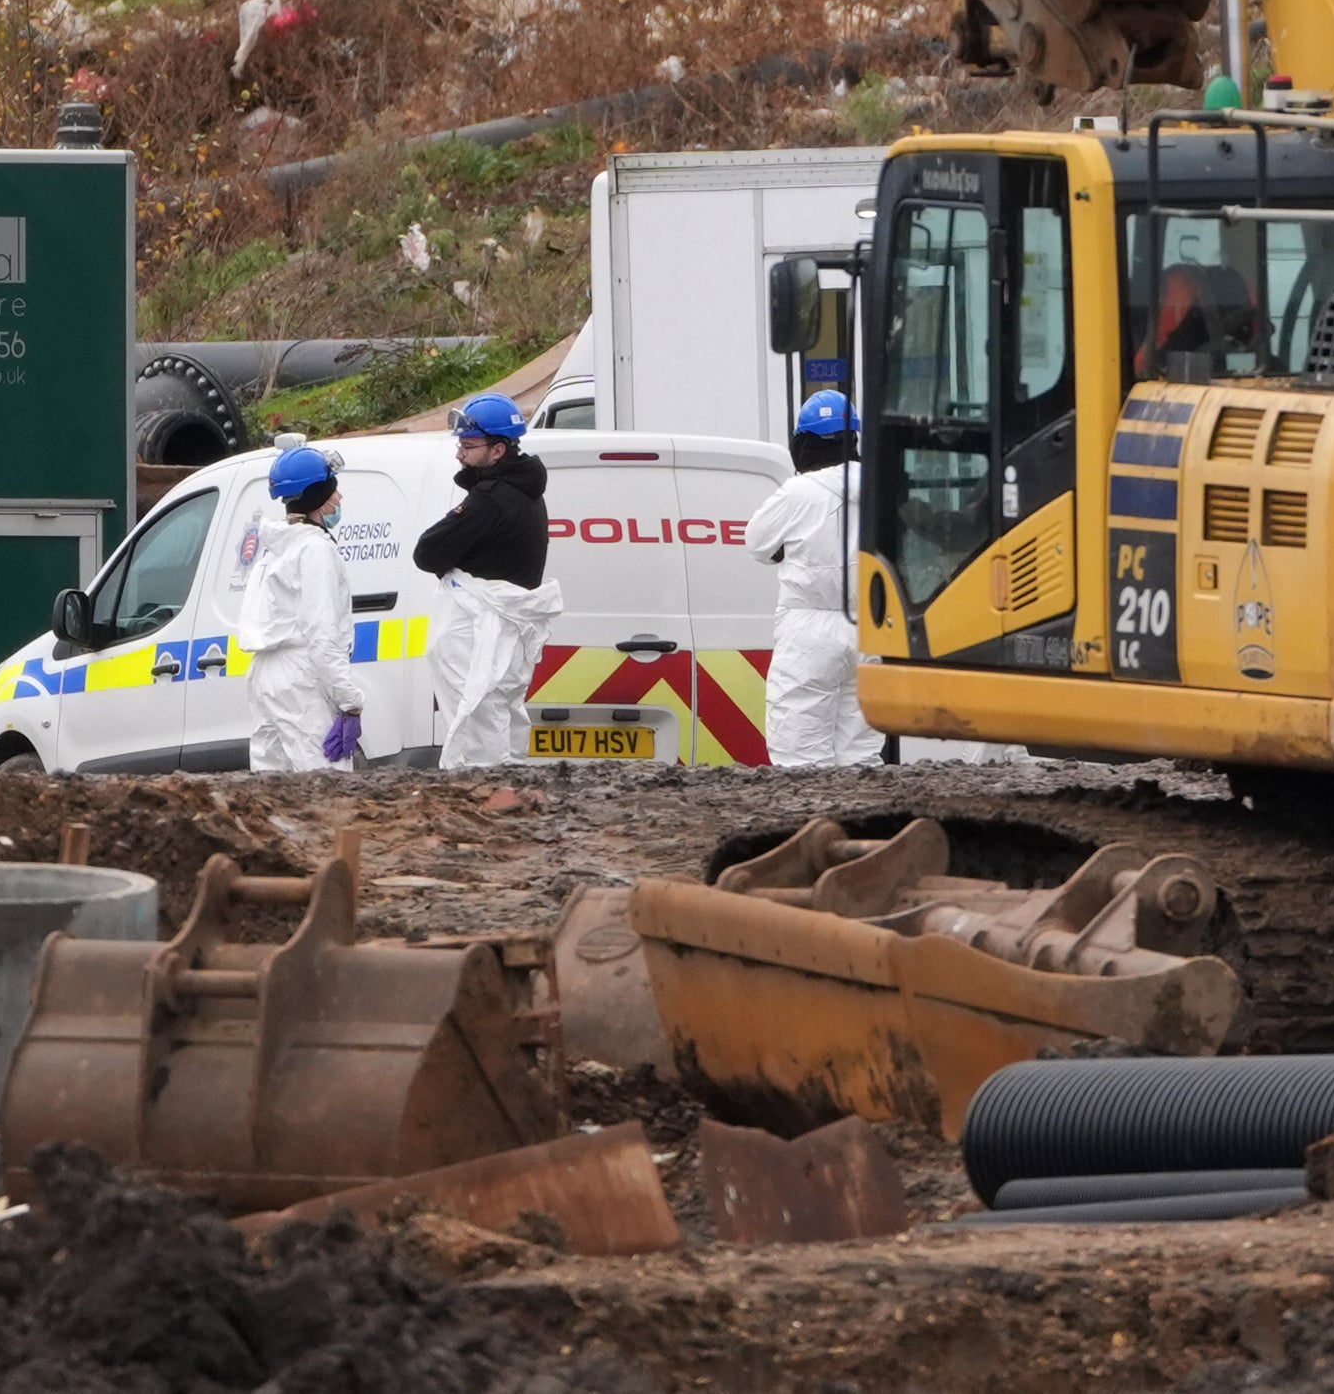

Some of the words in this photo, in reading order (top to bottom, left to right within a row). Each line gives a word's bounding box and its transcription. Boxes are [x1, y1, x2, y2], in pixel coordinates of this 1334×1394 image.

[337, 522, 392, 542] FORENSIC
[548, 517, 749, 546] POLICE
[336, 543, 400, 562] ESTIGATION
[1116, 543, 1147, 581] PC
[1115, 586, 1171, 637] 210
[1118, 639, 1141, 669] LC
[534, 729, 587, 753] EU17
[594, 730, 638, 754] HSV
